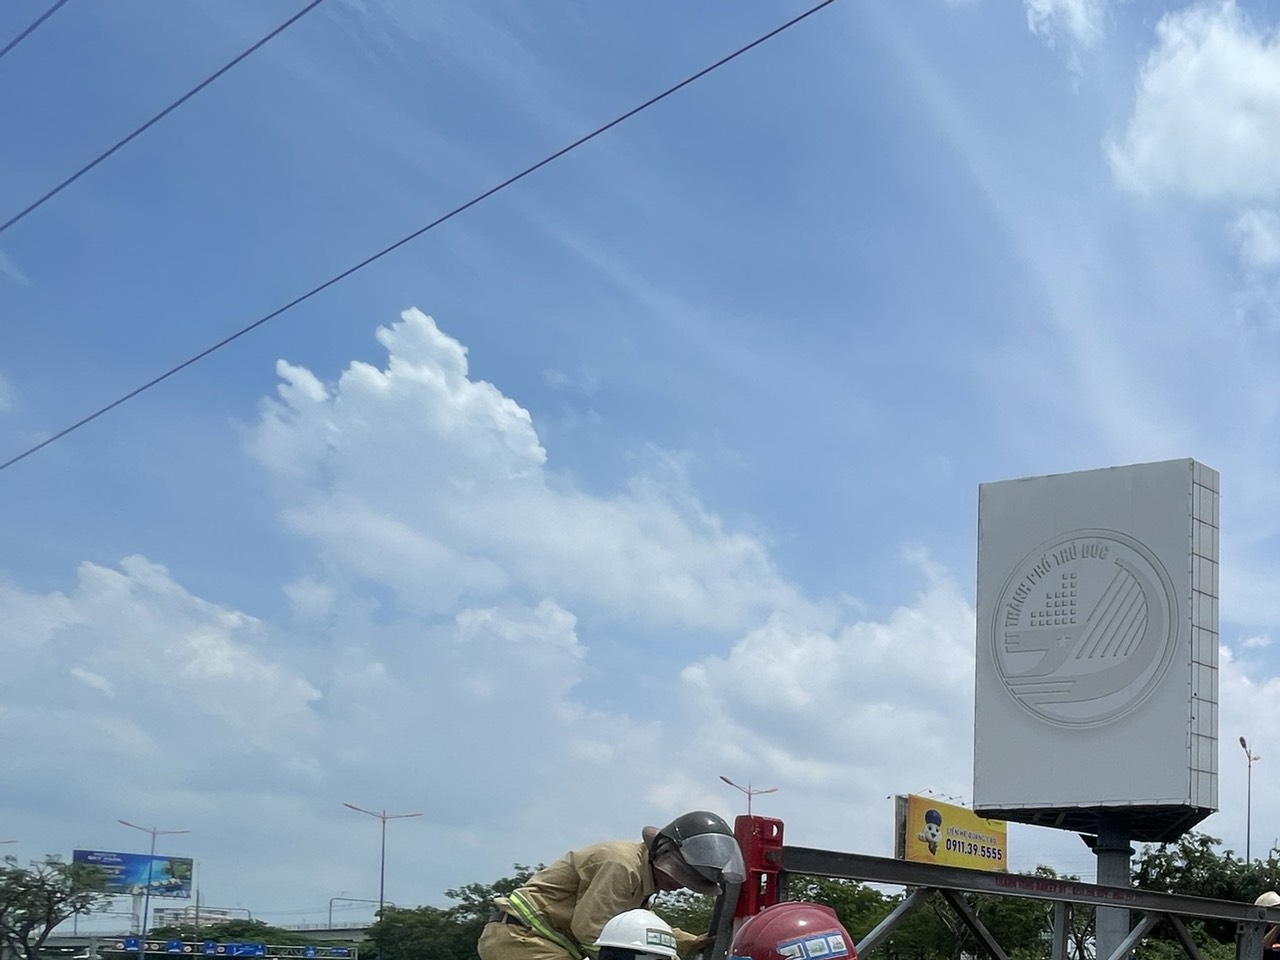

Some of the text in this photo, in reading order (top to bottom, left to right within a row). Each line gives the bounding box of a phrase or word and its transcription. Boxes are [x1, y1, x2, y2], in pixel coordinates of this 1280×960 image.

[1004, 541, 1109, 627] THÀNH PHỐ THỦ ĐỨC
[945, 838, 1003, 861] 0911.39.5555
